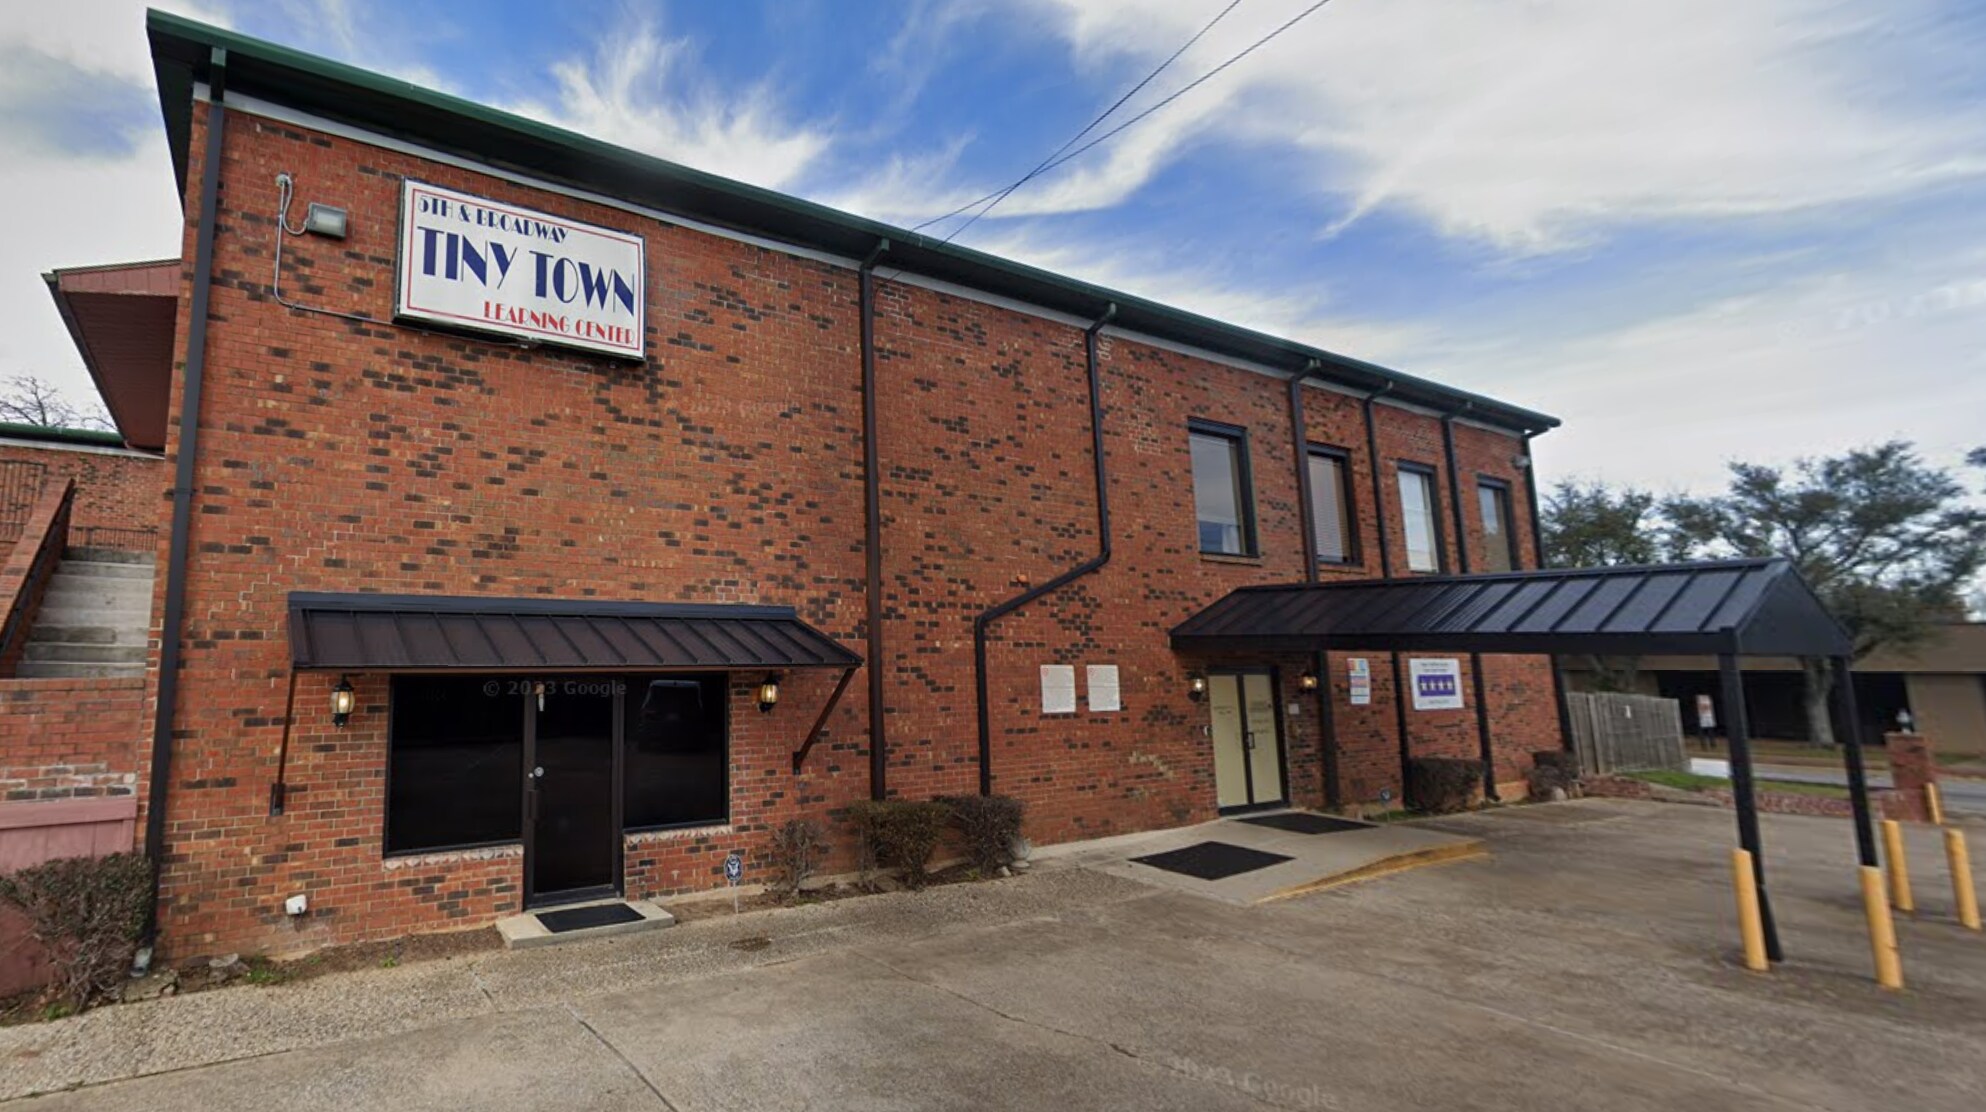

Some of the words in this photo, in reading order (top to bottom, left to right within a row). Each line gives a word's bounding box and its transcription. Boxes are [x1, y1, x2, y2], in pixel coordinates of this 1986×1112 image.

[418, 195, 453, 219] 5TH
[458, 204, 470, 222] &
[476, 208, 568, 244] BROADWAY
[417, 226, 518, 290] TINY
[529, 250, 635, 317] TOWN
[484, 301, 570, 334] LEARNING
[575, 319, 635, 346] CENTER
